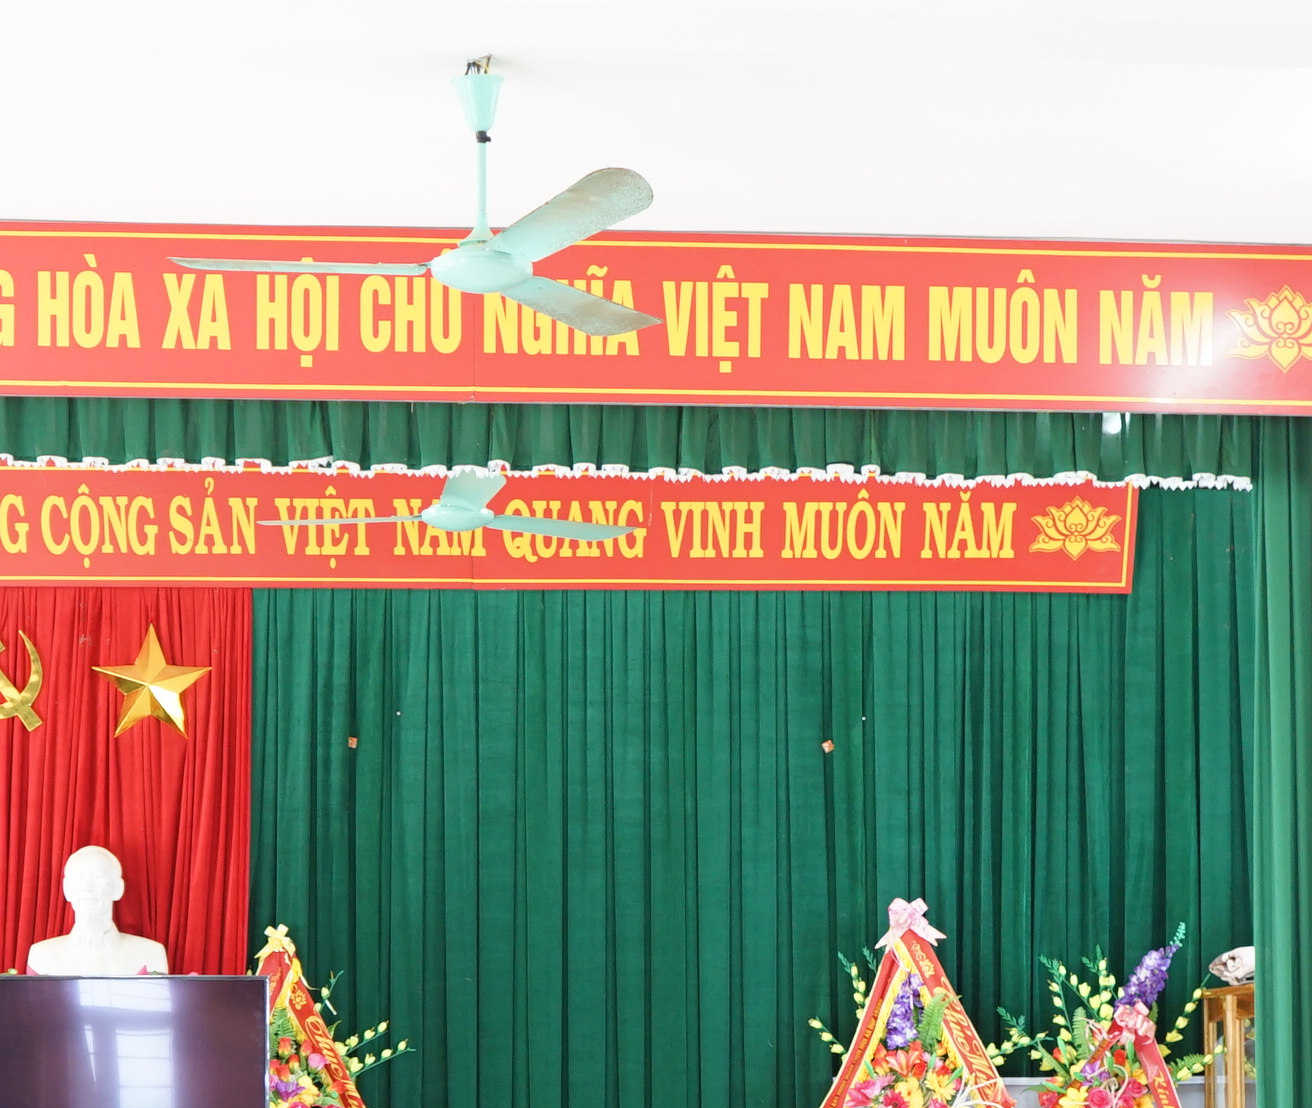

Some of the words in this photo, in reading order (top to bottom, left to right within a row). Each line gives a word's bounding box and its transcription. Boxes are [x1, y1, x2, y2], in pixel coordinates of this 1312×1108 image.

[38, 254, 140, 348] HÒA
[484, 265, 639, 355] NGHĨA
[663, 265, 768, 373] VIỆT
[789, 284, 905, 360] NAM
[929, 269, 1077, 363] MUÔN
[1100, 275, 1213, 365] NĂM
[41, 484, 158, 568] CỘNG
[169, 478, 257, 554] SẢN
[275, 486, 375, 568] VIỆT
[393, 499, 486, 556] NAM
[502, 499, 646, 562] QUANG
[661, 502, 764, 557] VINH
[781, 489, 905, 559] MUÔN
[921, 491, 1016, 558] NĂM
